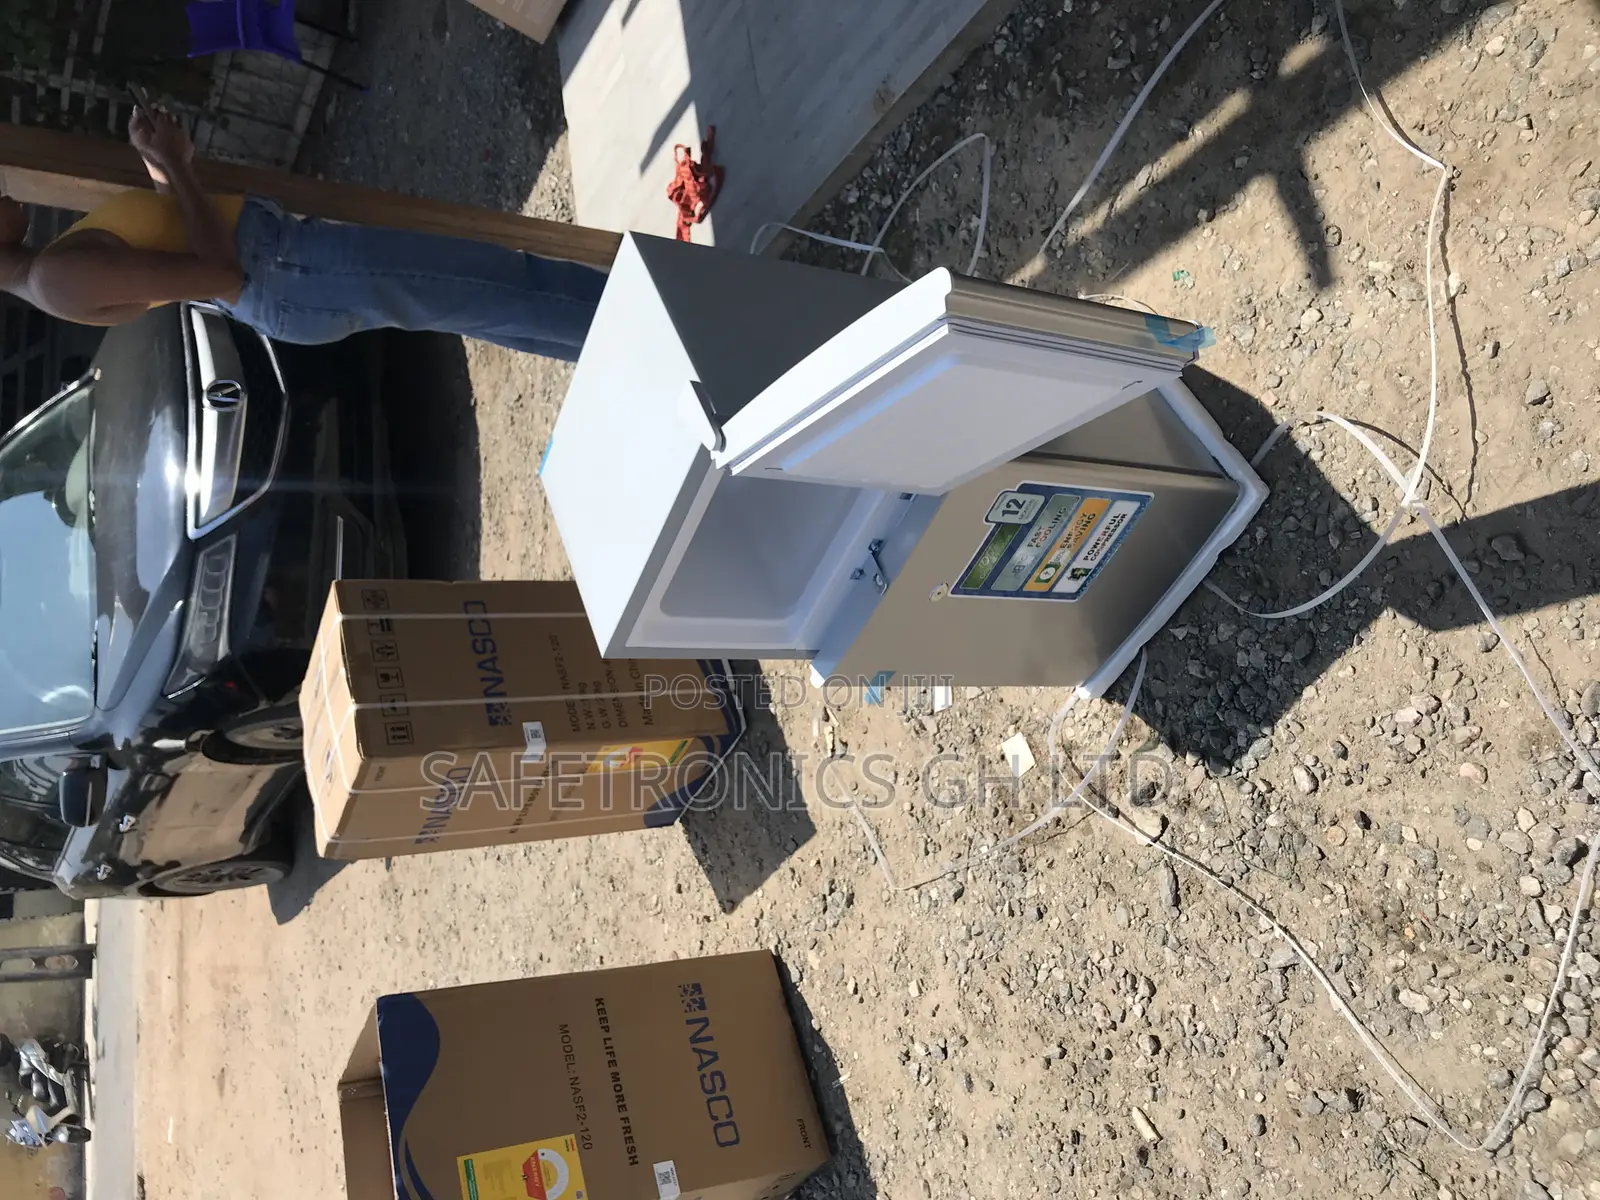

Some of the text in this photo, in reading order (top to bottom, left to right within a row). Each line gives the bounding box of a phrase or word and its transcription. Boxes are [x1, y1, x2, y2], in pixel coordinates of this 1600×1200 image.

[1001, 498, 1026, 518] 12
[1036, 507, 1067, 548] COOLING
[1027, 526, 1045, 548] FAST
[1083, 513, 1121, 561] POWERFUL
[1091, 513, 1128, 562] COMPRESSOR
[464, 601, 507, 698] NASCO
[558, 1024, 593, 1150] MODEL: NASF2-120
[595, 997, 639, 1165] KEEP LIFE MORE FRESH
[685, 1016, 740, 1148] NASCO
[797, 1118, 812, 1149] FRONT
